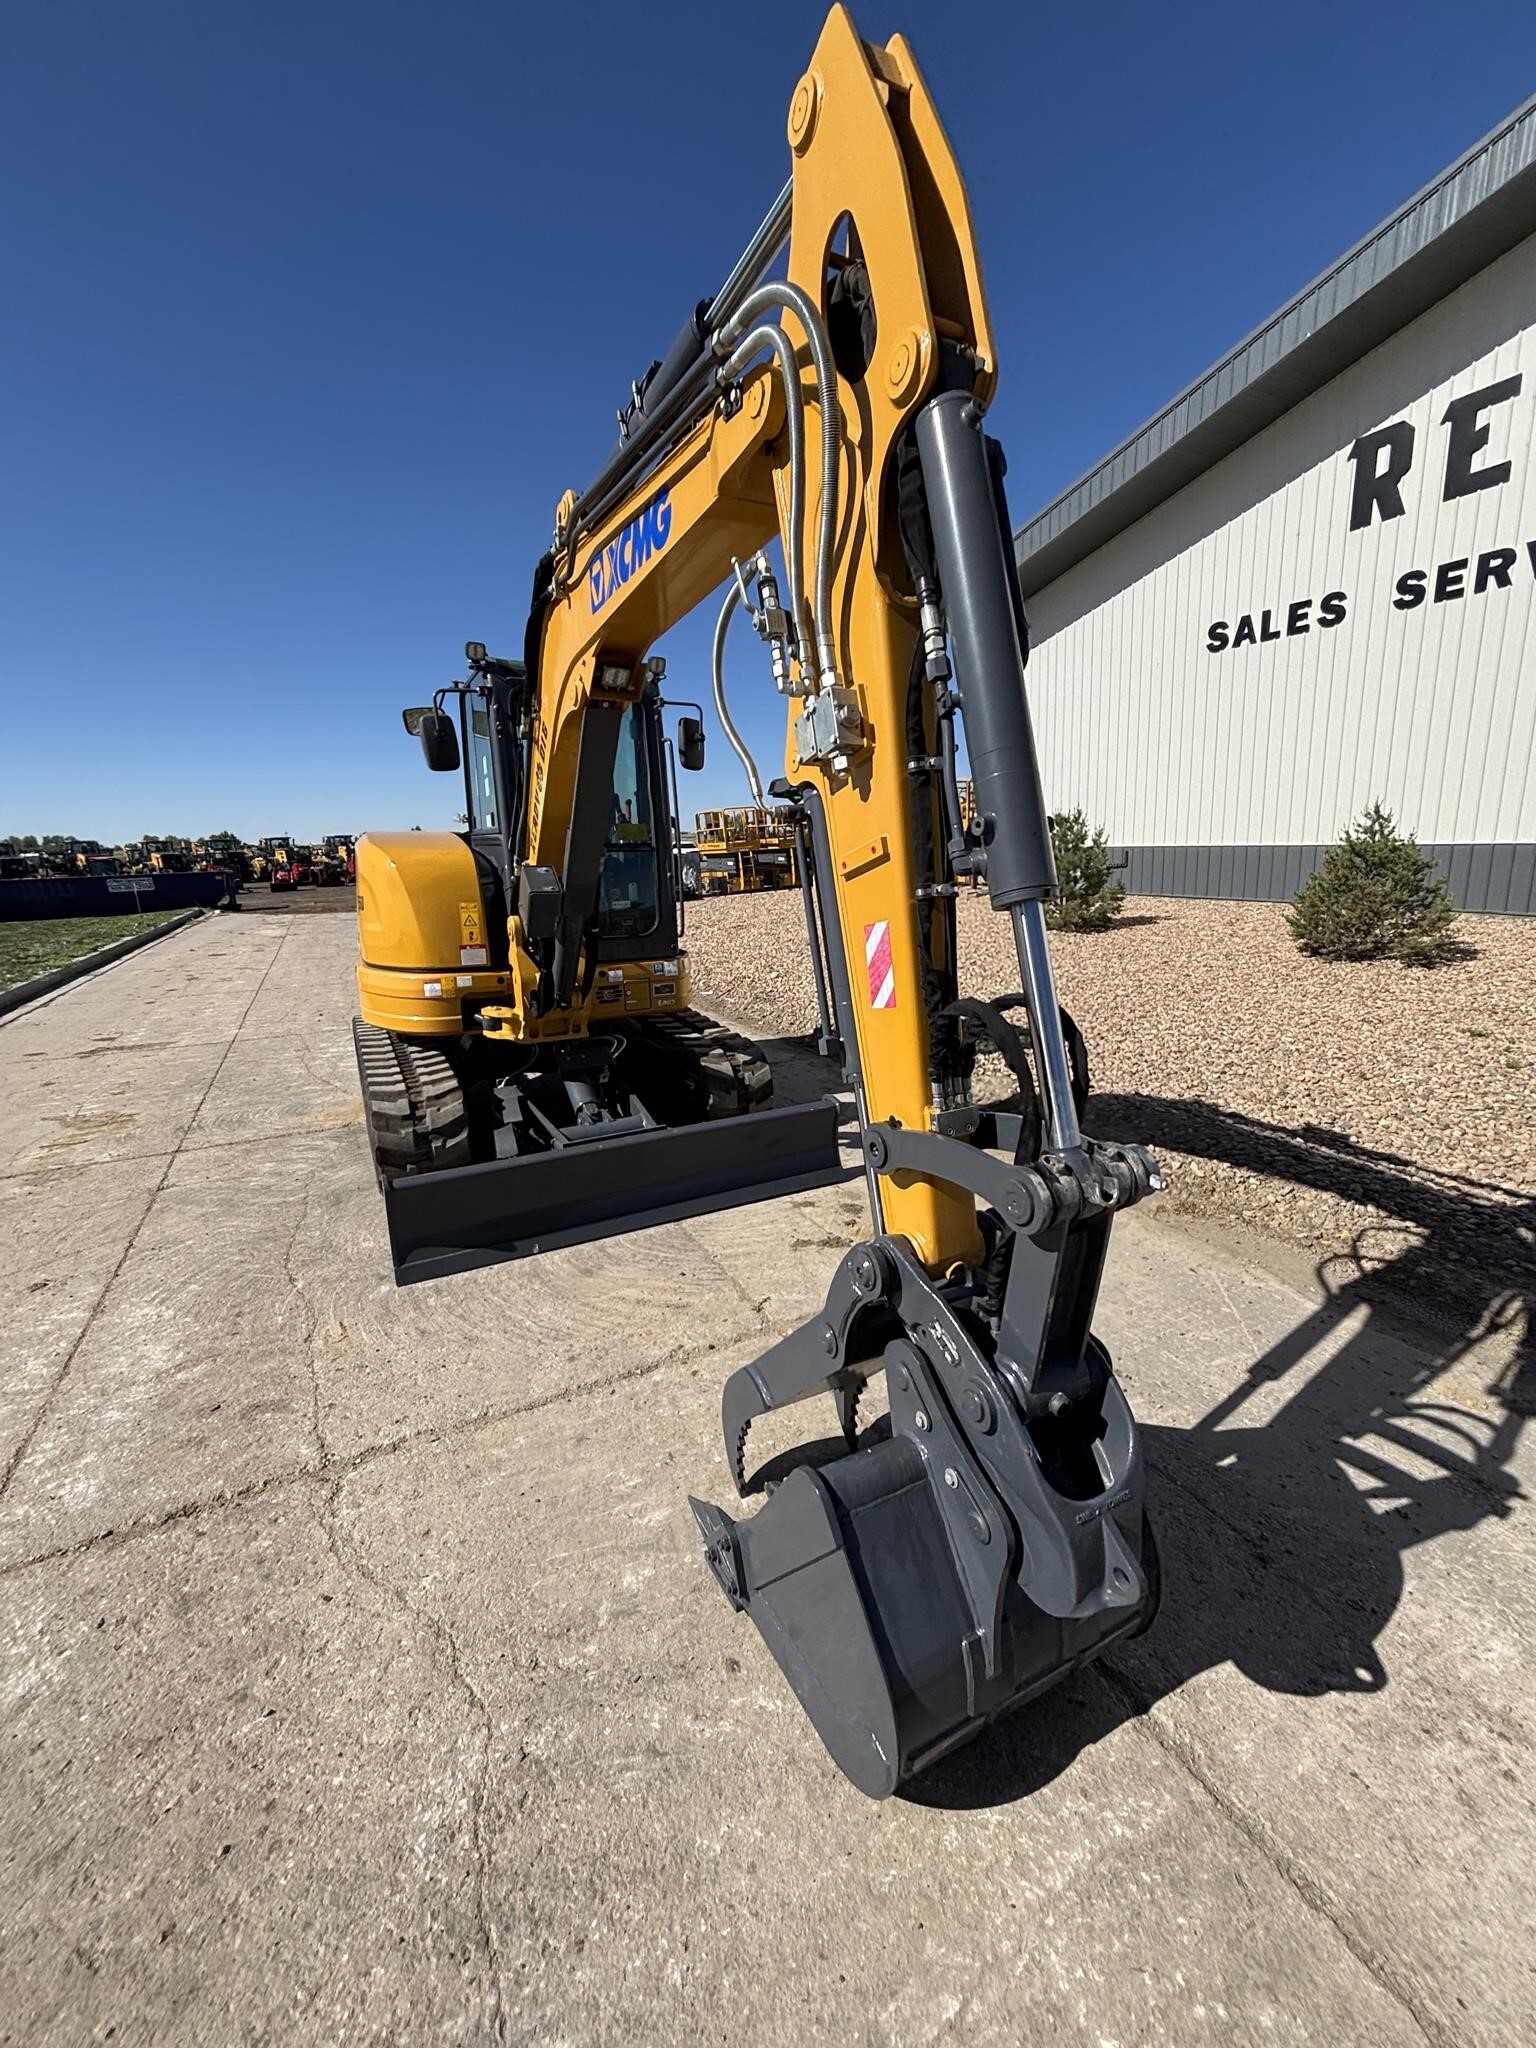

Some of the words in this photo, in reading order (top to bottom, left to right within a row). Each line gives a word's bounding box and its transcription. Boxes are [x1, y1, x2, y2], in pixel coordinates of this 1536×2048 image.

[603, 485, 672, 602] XCMG
[1206, 591, 1348, 653] SALES
[1393, 540, 1536, 610] SER
